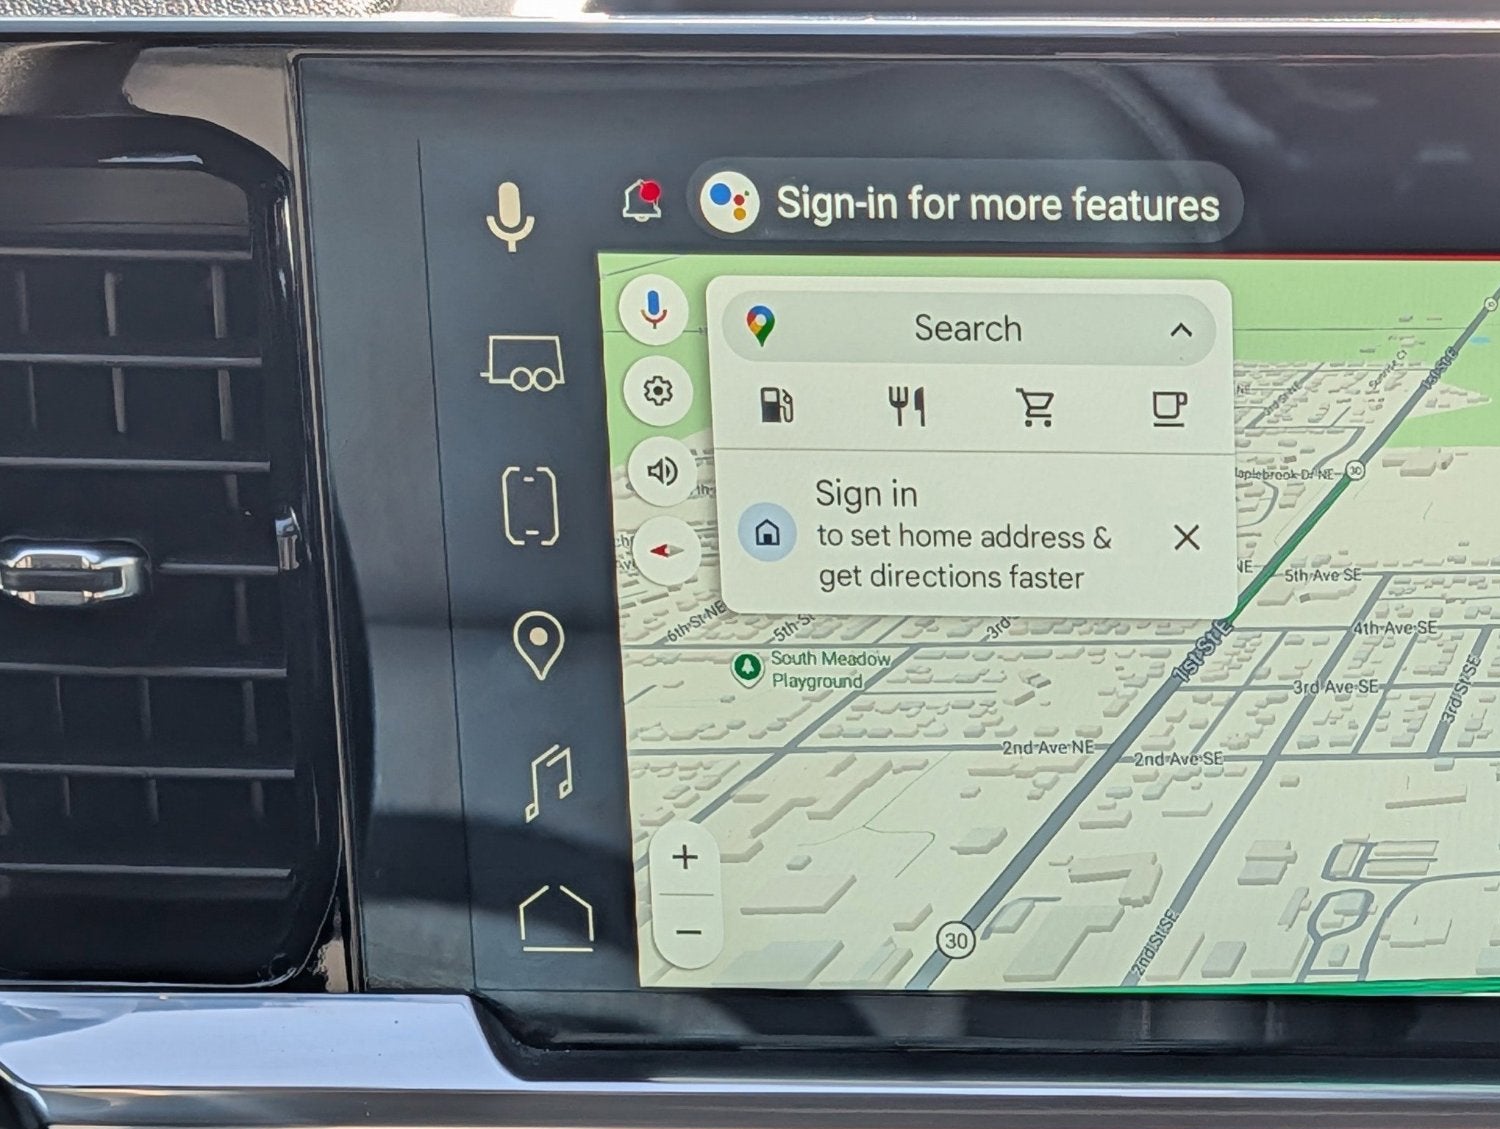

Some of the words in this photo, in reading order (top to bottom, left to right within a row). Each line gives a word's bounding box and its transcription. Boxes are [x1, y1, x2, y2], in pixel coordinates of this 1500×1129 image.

[777, 185, 902, 226] Sign-in
[908, 186, 960, 221] for
[970, 192, 1063, 221] more
[1070, 187, 1221, 223] features
[914, 314, 1023, 344] Search
[1235, 467, 1297, 480] aplebrook
[815, 479, 879, 515] Sign
[888, 479, 919, 508] in
[817, 524, 844, 548] to
[850, 524, 891, 548] set
[898, 522, 973, 549] home
[980, 522, 1086, 551] address
[1092, 525, 1113, 551] &
[819, 564, 864, 592] get
[870, 562, 1004, 589] directions
[1010, 564, 1086, 591] faster
[1285, 569, 1307, 582] 5th
[1313, 569, 1340, 581] Ave
[1343, 568, 1362, 581] SE
[667, 622, 690, 643] 6th
[690, 614, 706, 628] St
[704, 600, 727, 620] NE
[773, 620, 799, 642] 5th
[987, 616, 1012, 639] 3rd
[1353, 621, 1380, 636] 4th
[1386, 621, 1414, 635] Ave
[1417, 620, 1438, 635] SE
[771, 650, 817, 666] South
[821, 650, 892, 667] Meadow
[772, 672, 863, 692] Playground
[1293, 679, 1320, 694] 3rd
[1324, 680, 1355, 694] Ave
[1358, 679, 1379, 693] SE
[1441, 695, 1464, 724] 3rd
[1463, 655, 1482, 677] SE
[1002, 740, 1033, 755] 2nd
[1038, 741, 1068, 755] Ave
[1071, 739, 1095, 754] NE
[1133, 752, 1165, 767] 2nd
[1169, 753, 1200, 767] Ave
[1203, 752, 1224, 766] SE
[945, 933, 968, 949] 30
[1131, 946, 1155, 976] 2nd
[1149, 931, 1166, 952] St
[1160, 908, 1180, 934] SE
